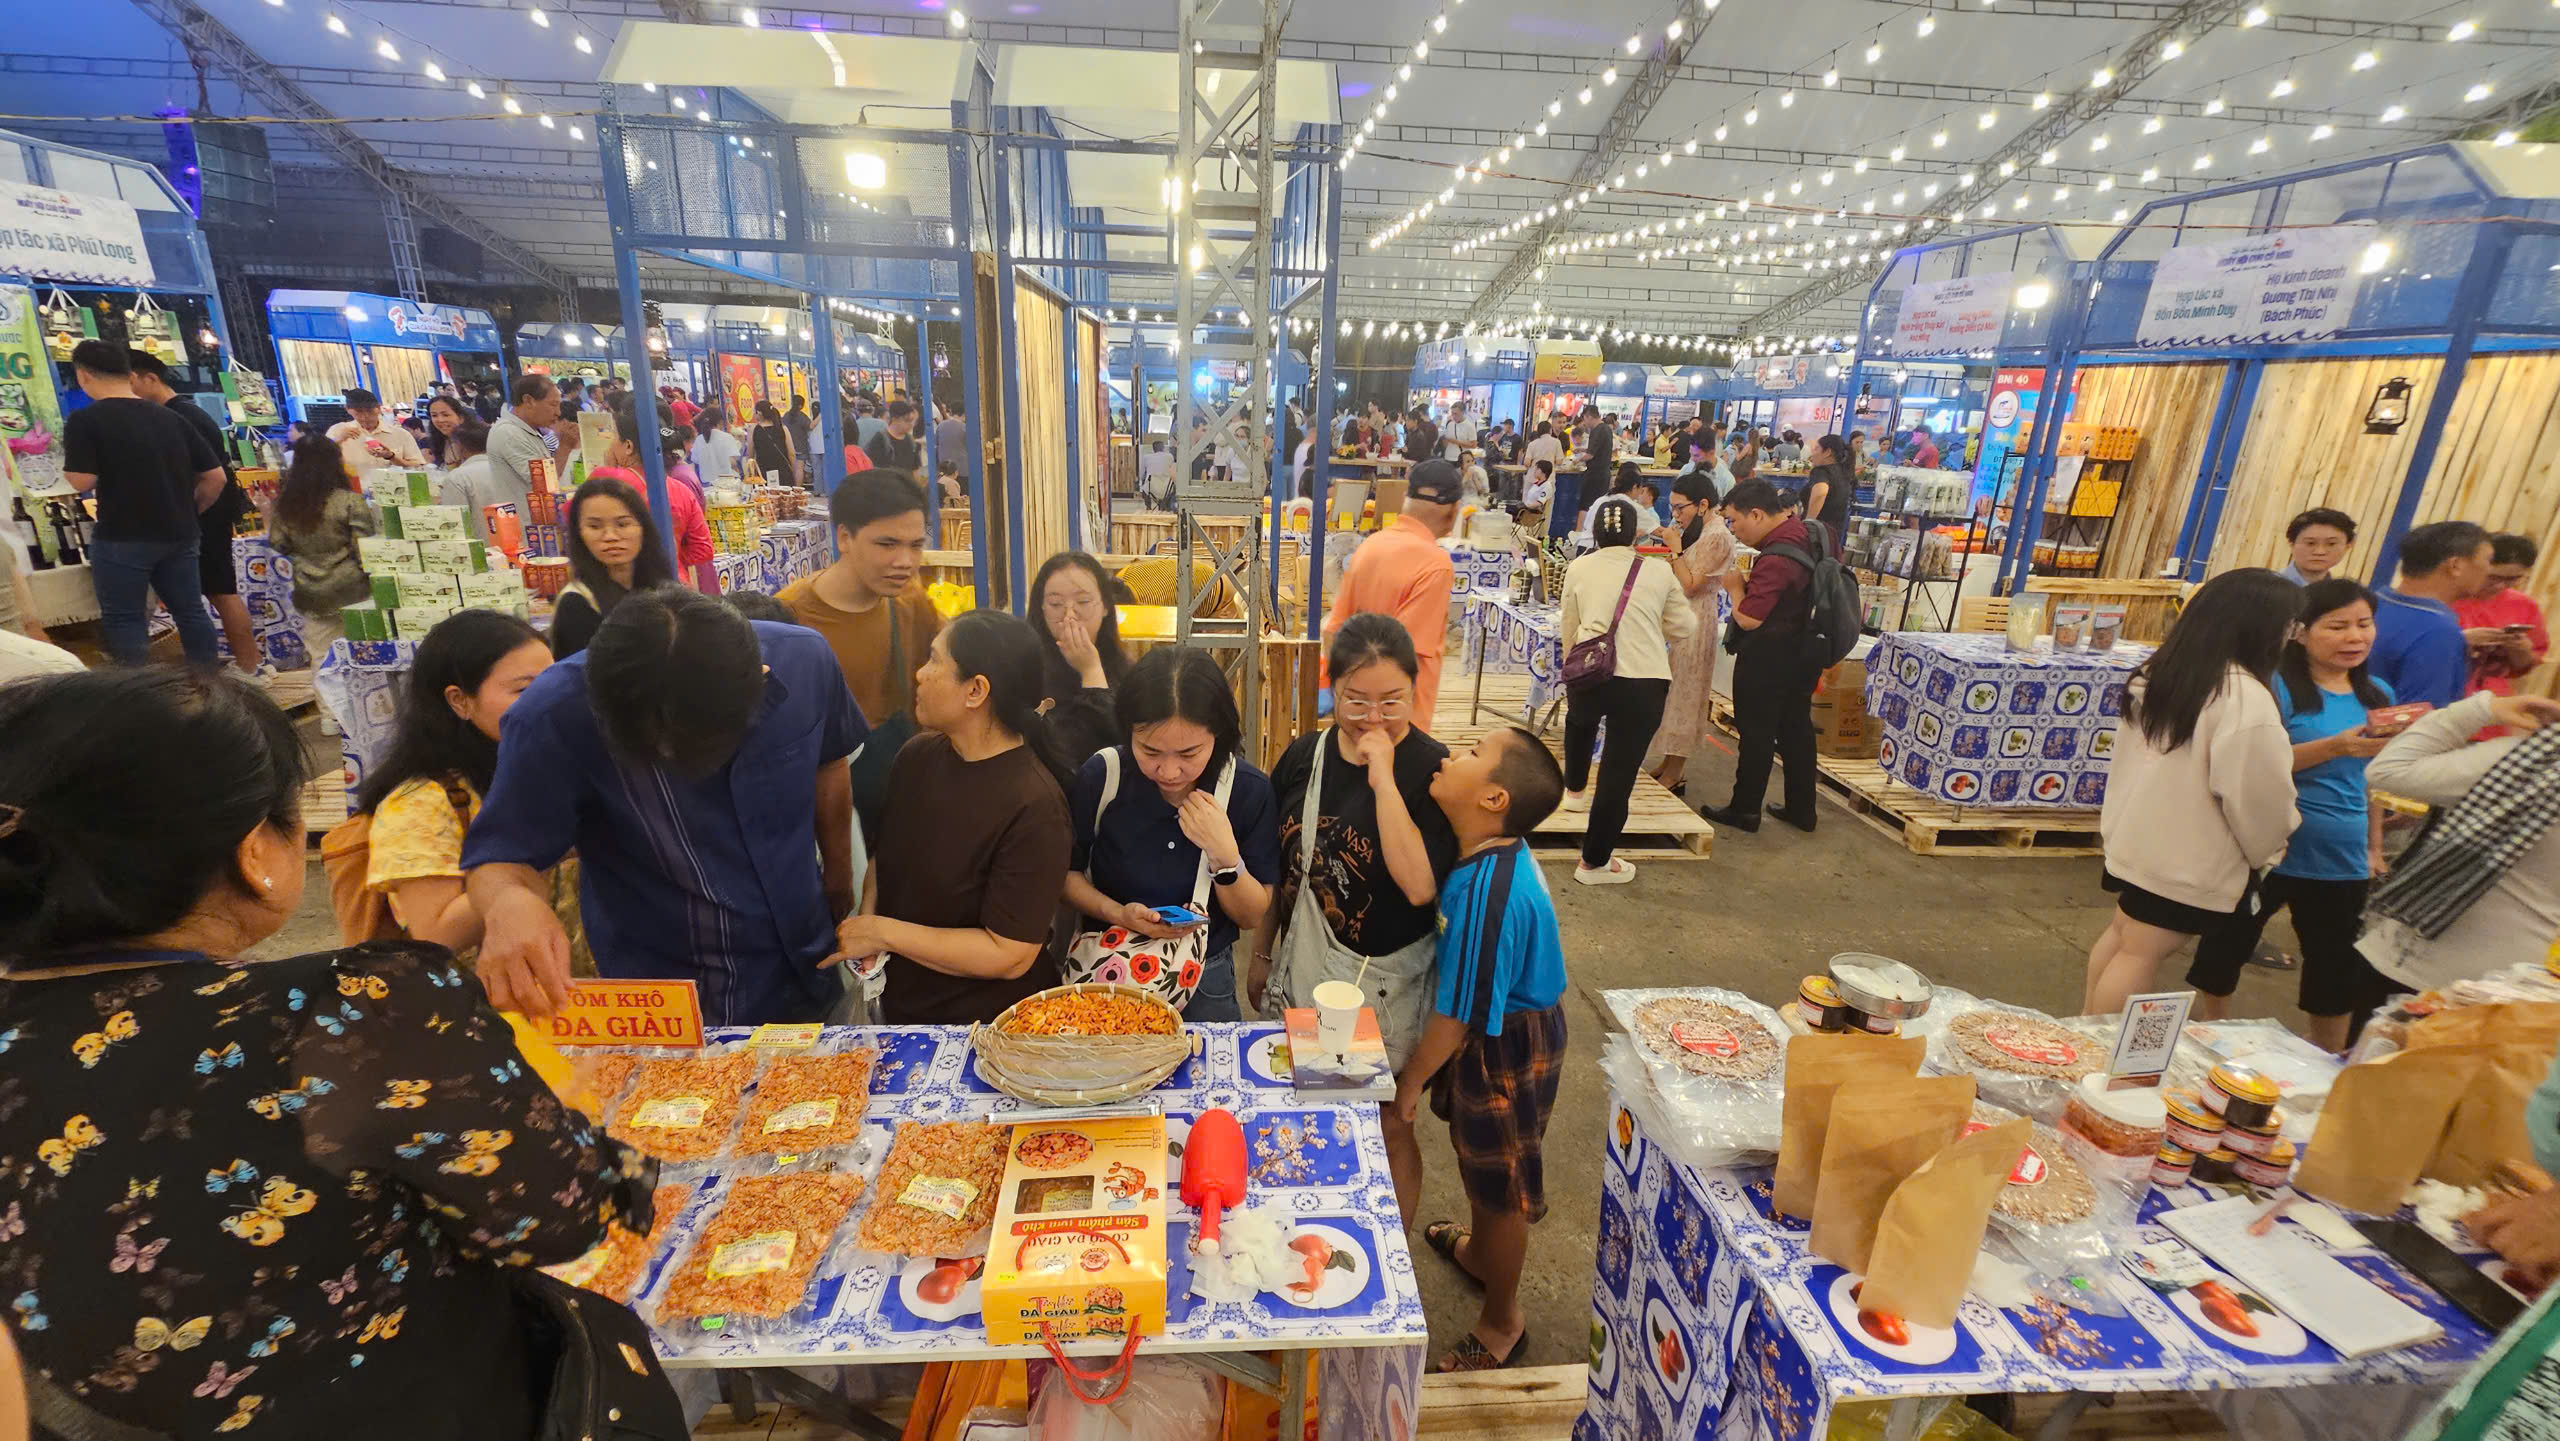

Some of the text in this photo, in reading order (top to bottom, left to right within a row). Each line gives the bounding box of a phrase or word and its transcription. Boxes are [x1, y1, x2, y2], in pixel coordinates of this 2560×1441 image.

[1997, 374, 2029, 385] BNI 40
[740, 397, 752, 409] FOOD
[1342, 825, 1374, 864] NASA
[567, 989, 665, 1008] ÔM KHÔ
[552, 1010, 683, 1038] ĐA GIÀU
